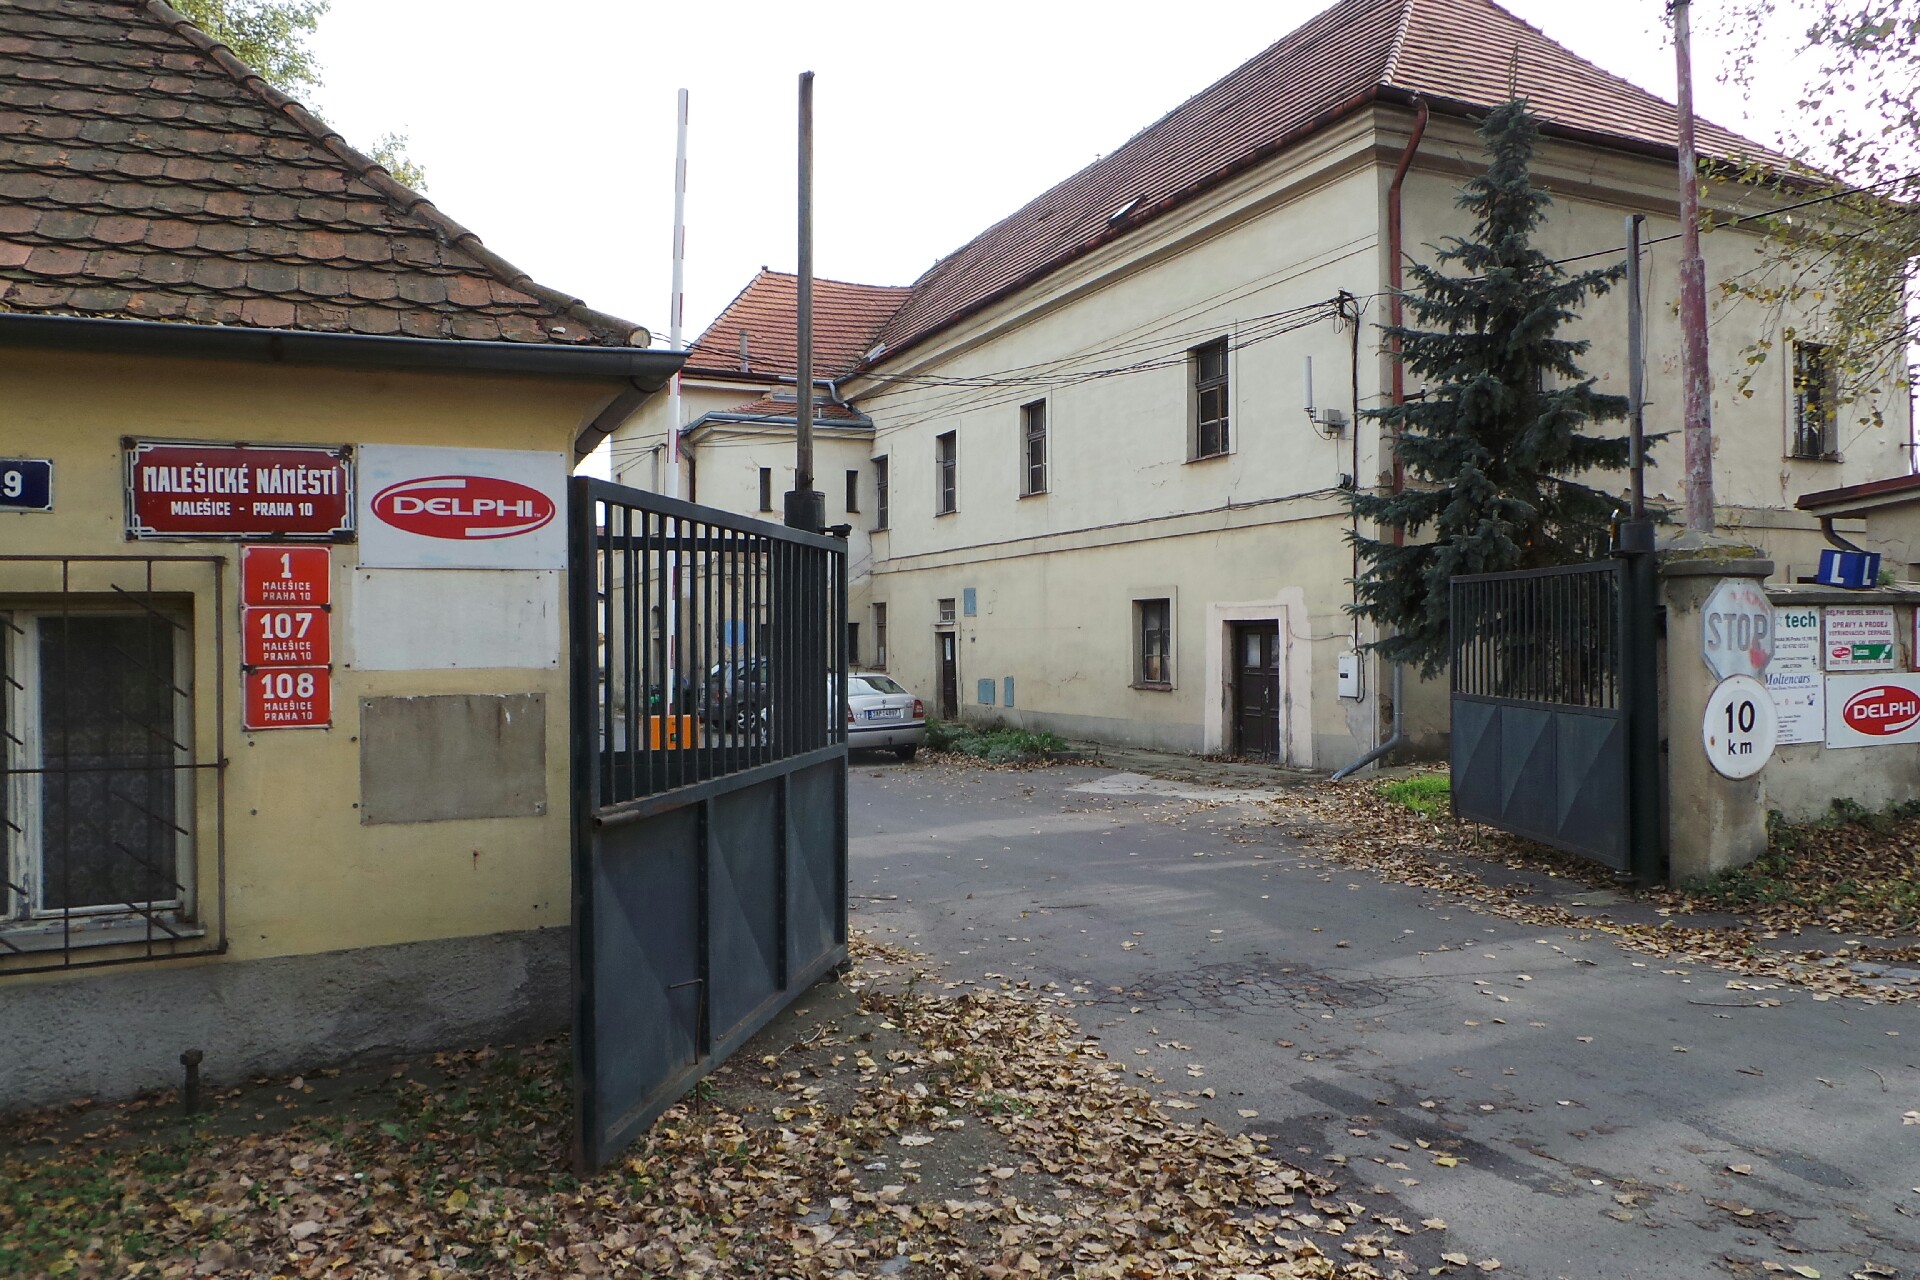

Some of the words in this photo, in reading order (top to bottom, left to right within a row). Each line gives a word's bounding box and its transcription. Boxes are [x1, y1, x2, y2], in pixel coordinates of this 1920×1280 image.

[2, 470, 23, 498] 9
[142, 462, 249, 494] MALEŠICKÉ
[256, 464, 338, 495] NÁMĚSTÍ
[171, 498, 231, 516] MALEŠICE
[253, 502, 294, 517] PRAHA
[298, 503, 313, 516] 10
[393, 496, 533, 518] DELPHI
[280, 553, 292, 579] 1
[1830, 553, 1845, 584] L
[1862, 555, 1872, 586] L
[262, 580, 311, 591] MALEŠICE
[262, 592, 296, 601] PRAHA
[300, 592, 311, 600] 10
[260, 613, 313, 639] 107
[1784, 611, 1817, 628] tech
[1832, 621, 1857, 629] OPRAVY
[1708, 612, 1768, 651] STOP
[262, 640, 311, 651] MALEŠICE
[263, 652, 297, 661] PRAHA
[300, 652, 312, 660] 10
[261, 673, 314, 699] 108
[264, 700, 312, 711] MALEŠICE
[1853, 701, 1916, 720] DELPHI
[264, 712, 298, 721] PRAHA
[301, 712, 313, 720] 10
[1725, 700, 1756, 734] 10
[1728, 739, 1752, 755] km
